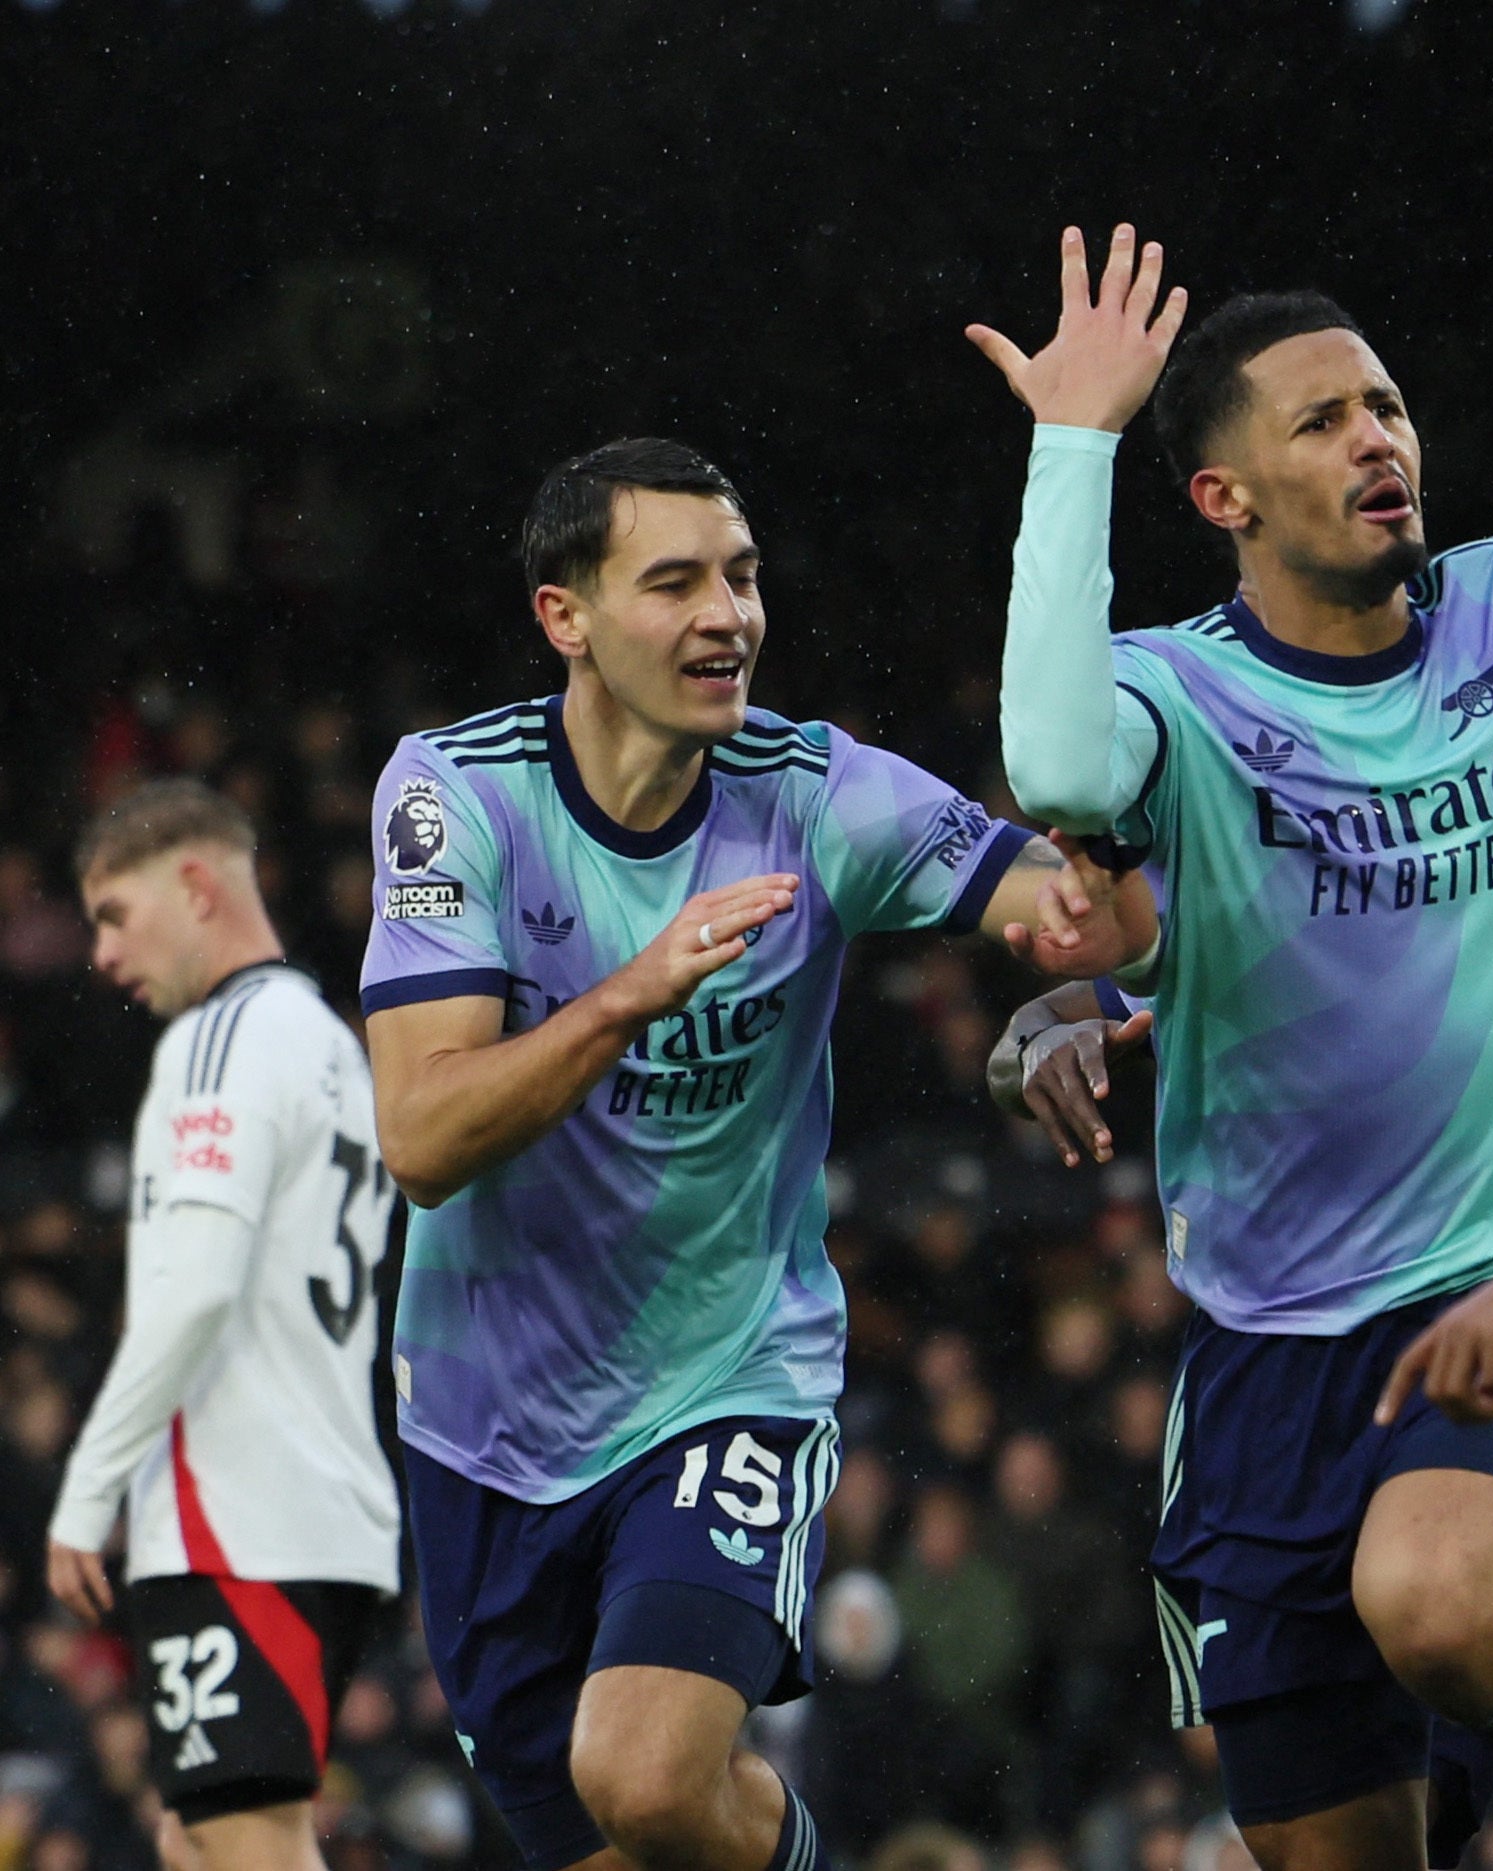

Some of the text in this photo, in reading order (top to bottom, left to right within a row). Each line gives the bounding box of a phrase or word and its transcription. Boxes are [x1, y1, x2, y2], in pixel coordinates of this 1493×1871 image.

[386, 885, 455, 904] No room
[402, 901, 464, 918] racism
[1310, 862, 1378, 917] FLY
[608, 1058, 751, 1117] BETTER
[673, 1431, 783, 1528] 15
[149, 1624, 241, 1733] 32
